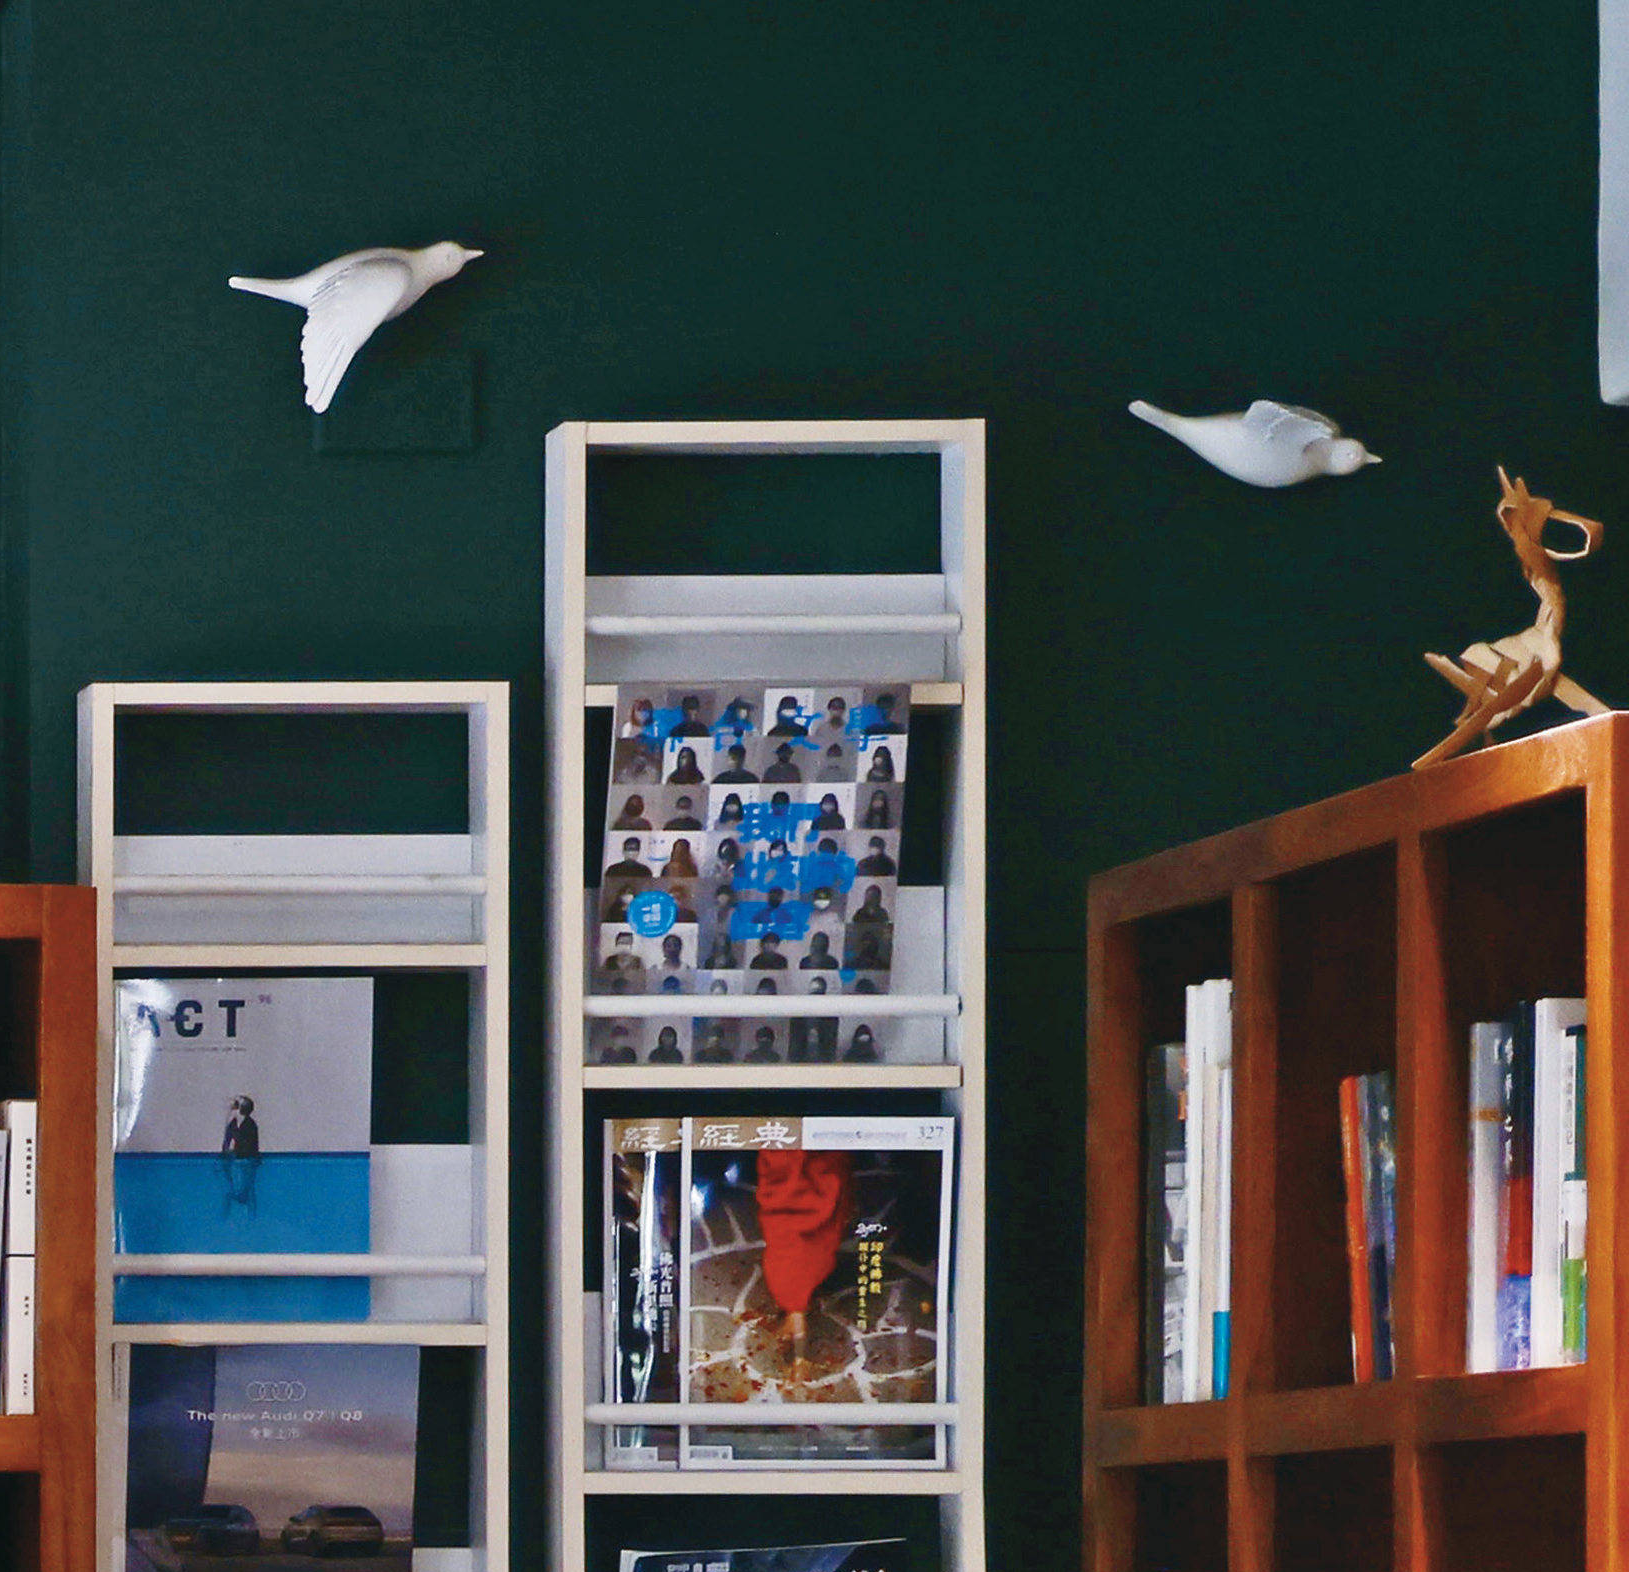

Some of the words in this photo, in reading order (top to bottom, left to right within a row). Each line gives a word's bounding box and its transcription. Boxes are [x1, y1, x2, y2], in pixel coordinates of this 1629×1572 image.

[698, 1122, 798, 1149] 經典
[187, 1410, 216, 1421] The
[261, 1410, 299, 1422] Audi
[339, 1410, 364, 1422] Q8
